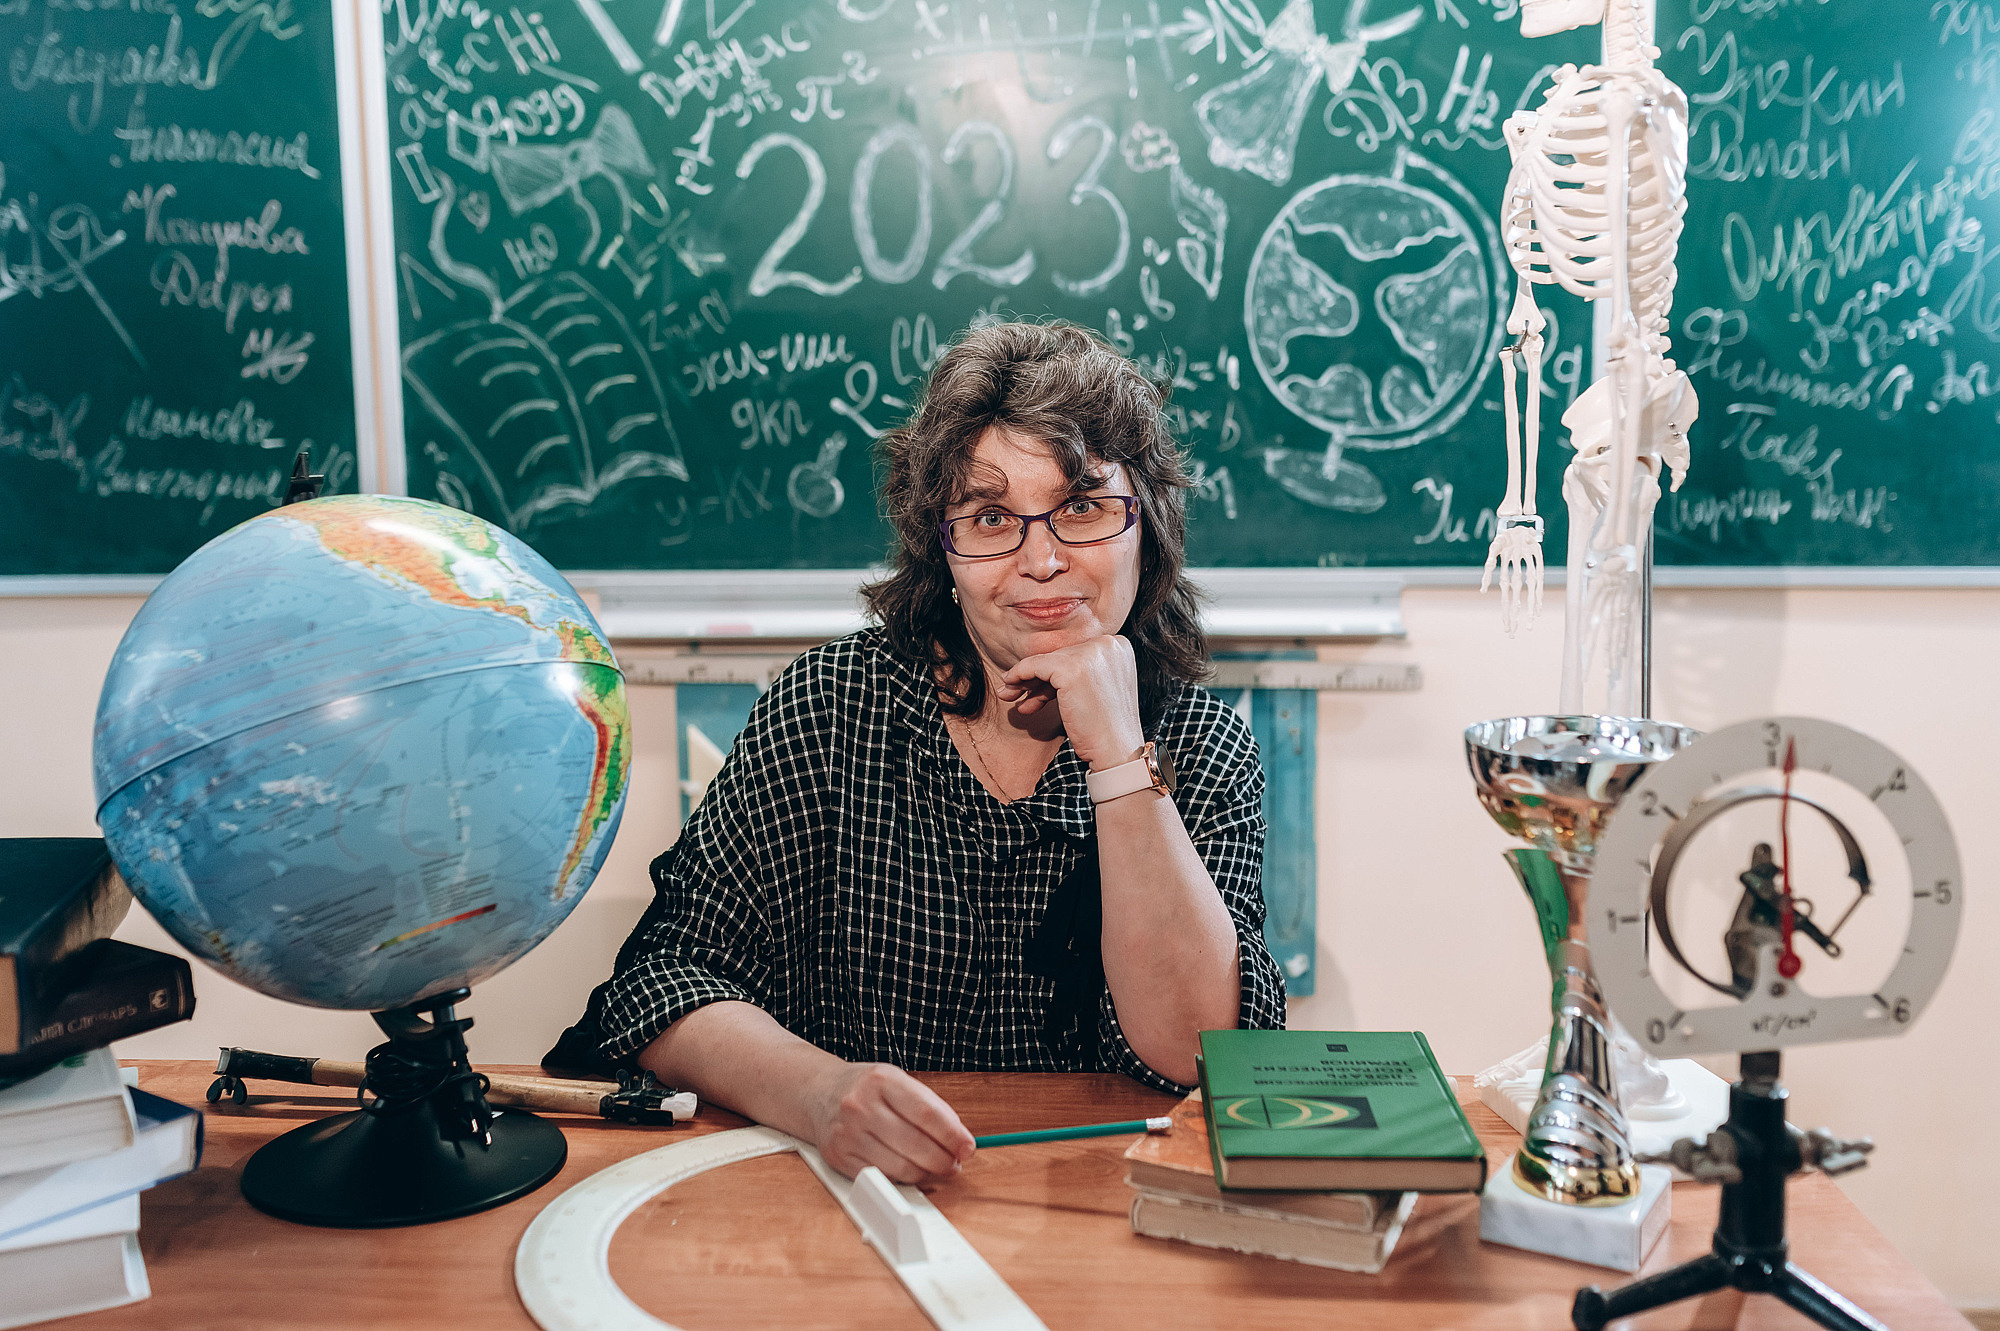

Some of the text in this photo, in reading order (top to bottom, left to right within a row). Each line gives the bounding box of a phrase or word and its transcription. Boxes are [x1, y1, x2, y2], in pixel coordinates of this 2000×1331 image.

[735, 114, 1131, 298] 2023
[1762, 721, 1781, 748] 3
[1888, 768, 1907, 792] 4
[1641, 790, 1661, 816] 2
[1934, 881, 1952, 905] 5
[1893, 998, 1911, 1024] 6
[1646, 1018, 1665, 1045] 0
